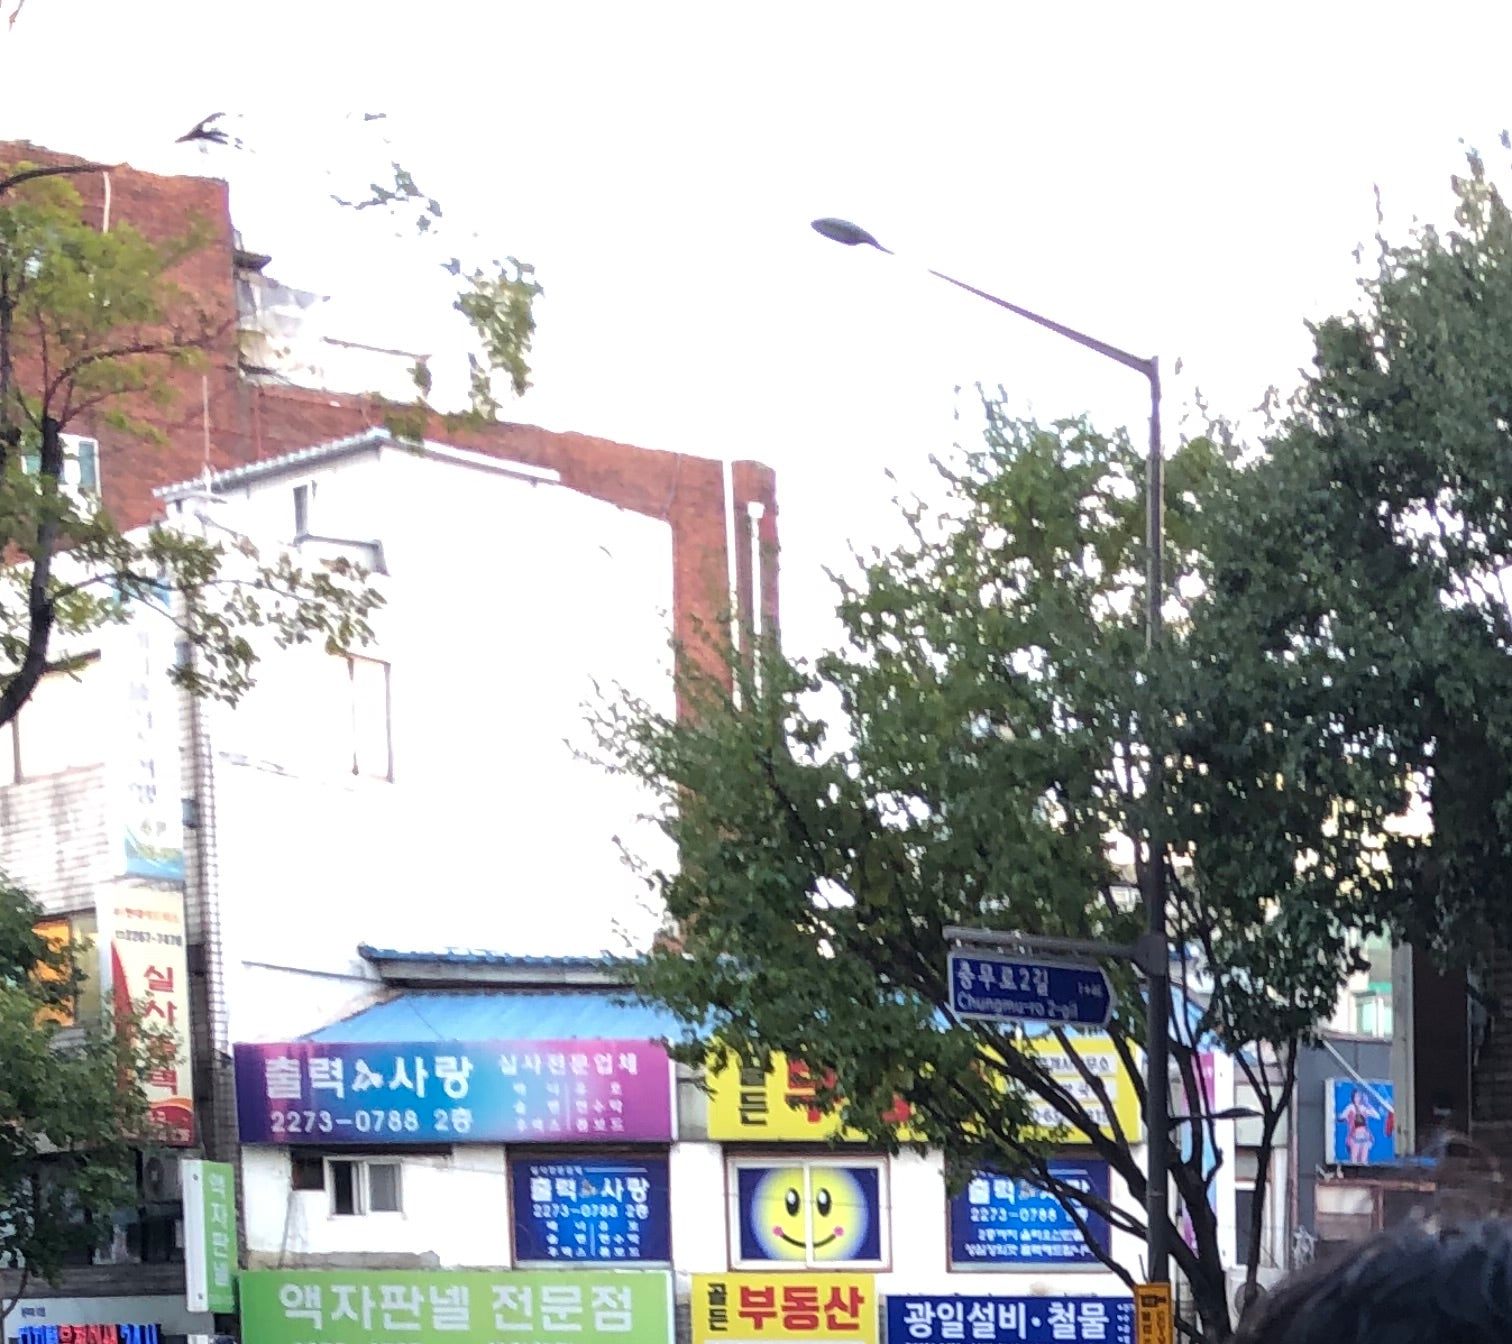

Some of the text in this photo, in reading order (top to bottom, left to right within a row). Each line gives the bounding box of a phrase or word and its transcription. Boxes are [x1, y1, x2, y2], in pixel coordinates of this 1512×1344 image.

[957, 960, 1048, 997] 충무로2길
[143, 964, 180, 1095] 실사력
[271, 1107, 473, 1134] 2273-0788 2층
[279, 1283, 633, 1332] 액자판넬 전문점
[708, 1283, 865, 1331] 골든 부동산
